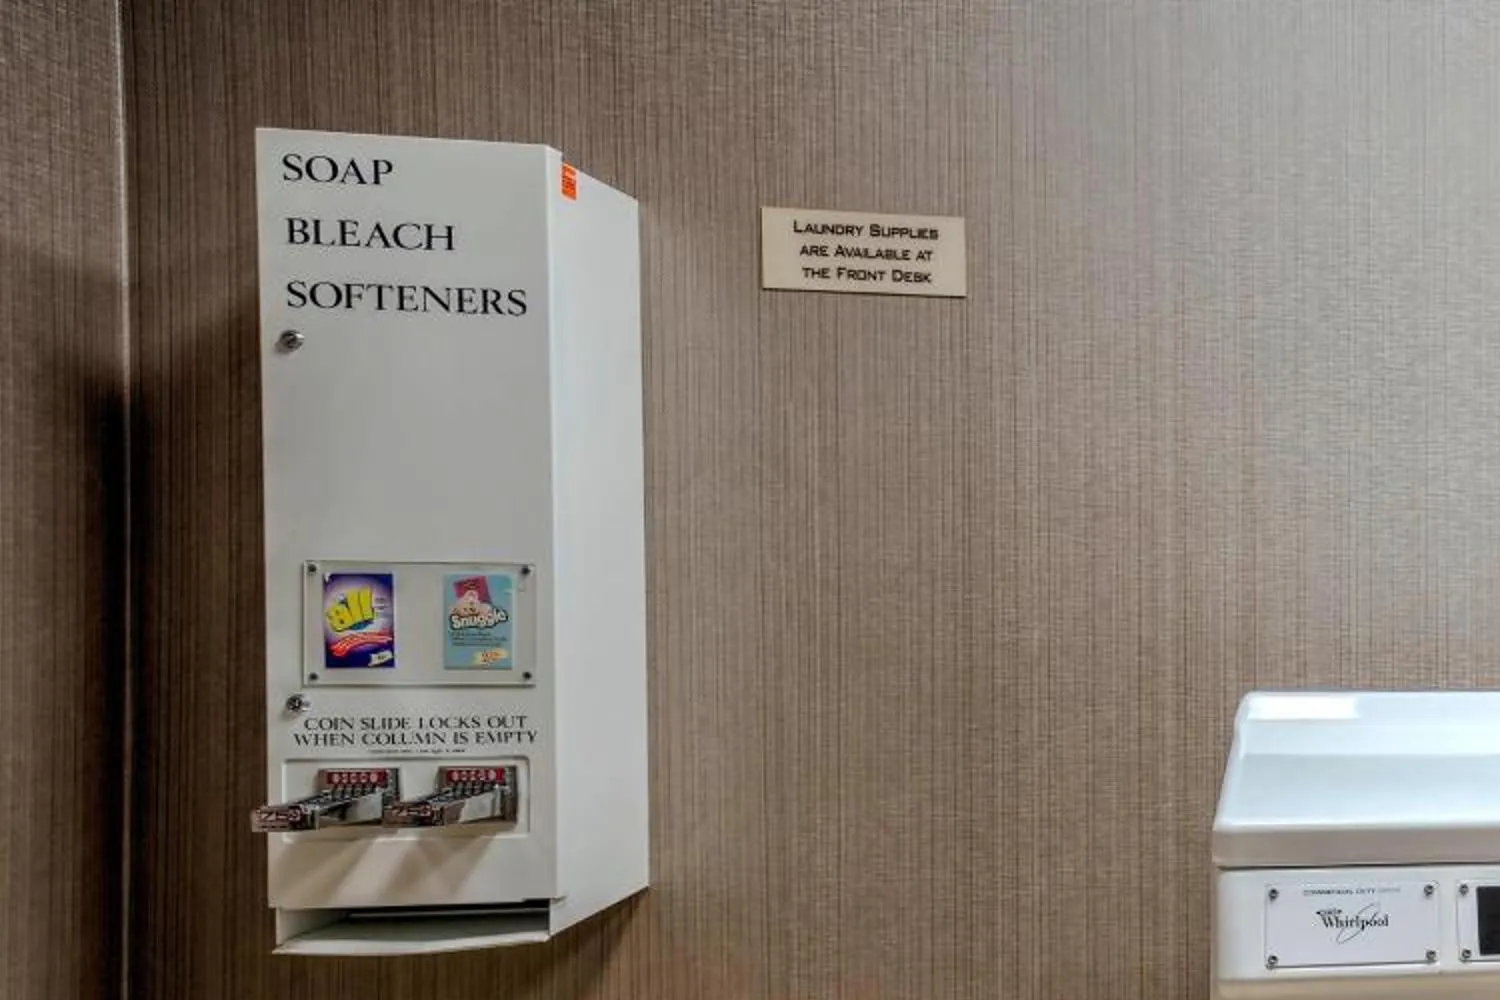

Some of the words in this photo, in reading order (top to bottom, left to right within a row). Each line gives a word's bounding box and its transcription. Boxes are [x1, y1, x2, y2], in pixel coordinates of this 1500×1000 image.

[282, 153, 393, 185] SOAP
[286, 217, 455, 251] BLEACH
[793, 219, 864, 237] LAUNDRY
[869, 223, 939, 241] SUPPLIES
[799, 245, 829, 257] ARE
[833, 244, 911, 261] AVAILABLE
[915, 249, 933, 262] AT
[802, 266, 830, 279] THE
[837, 267, 886, 282] FRONT
[891, 269, 932, 283] DESK
[286, 280, 528, 317] SOFTENERS
[304, 717, 354, 731] COIN
[360, 717, 412, 731] SLIDE
[487, 715, 528, 729] OUT
[294, 733, 355, 746] WHEN
[453, 732, 469, 744] IS
[475, 731, 537, 744] EMPTY
[1319, 911, 1389, 931] Whirlpool
